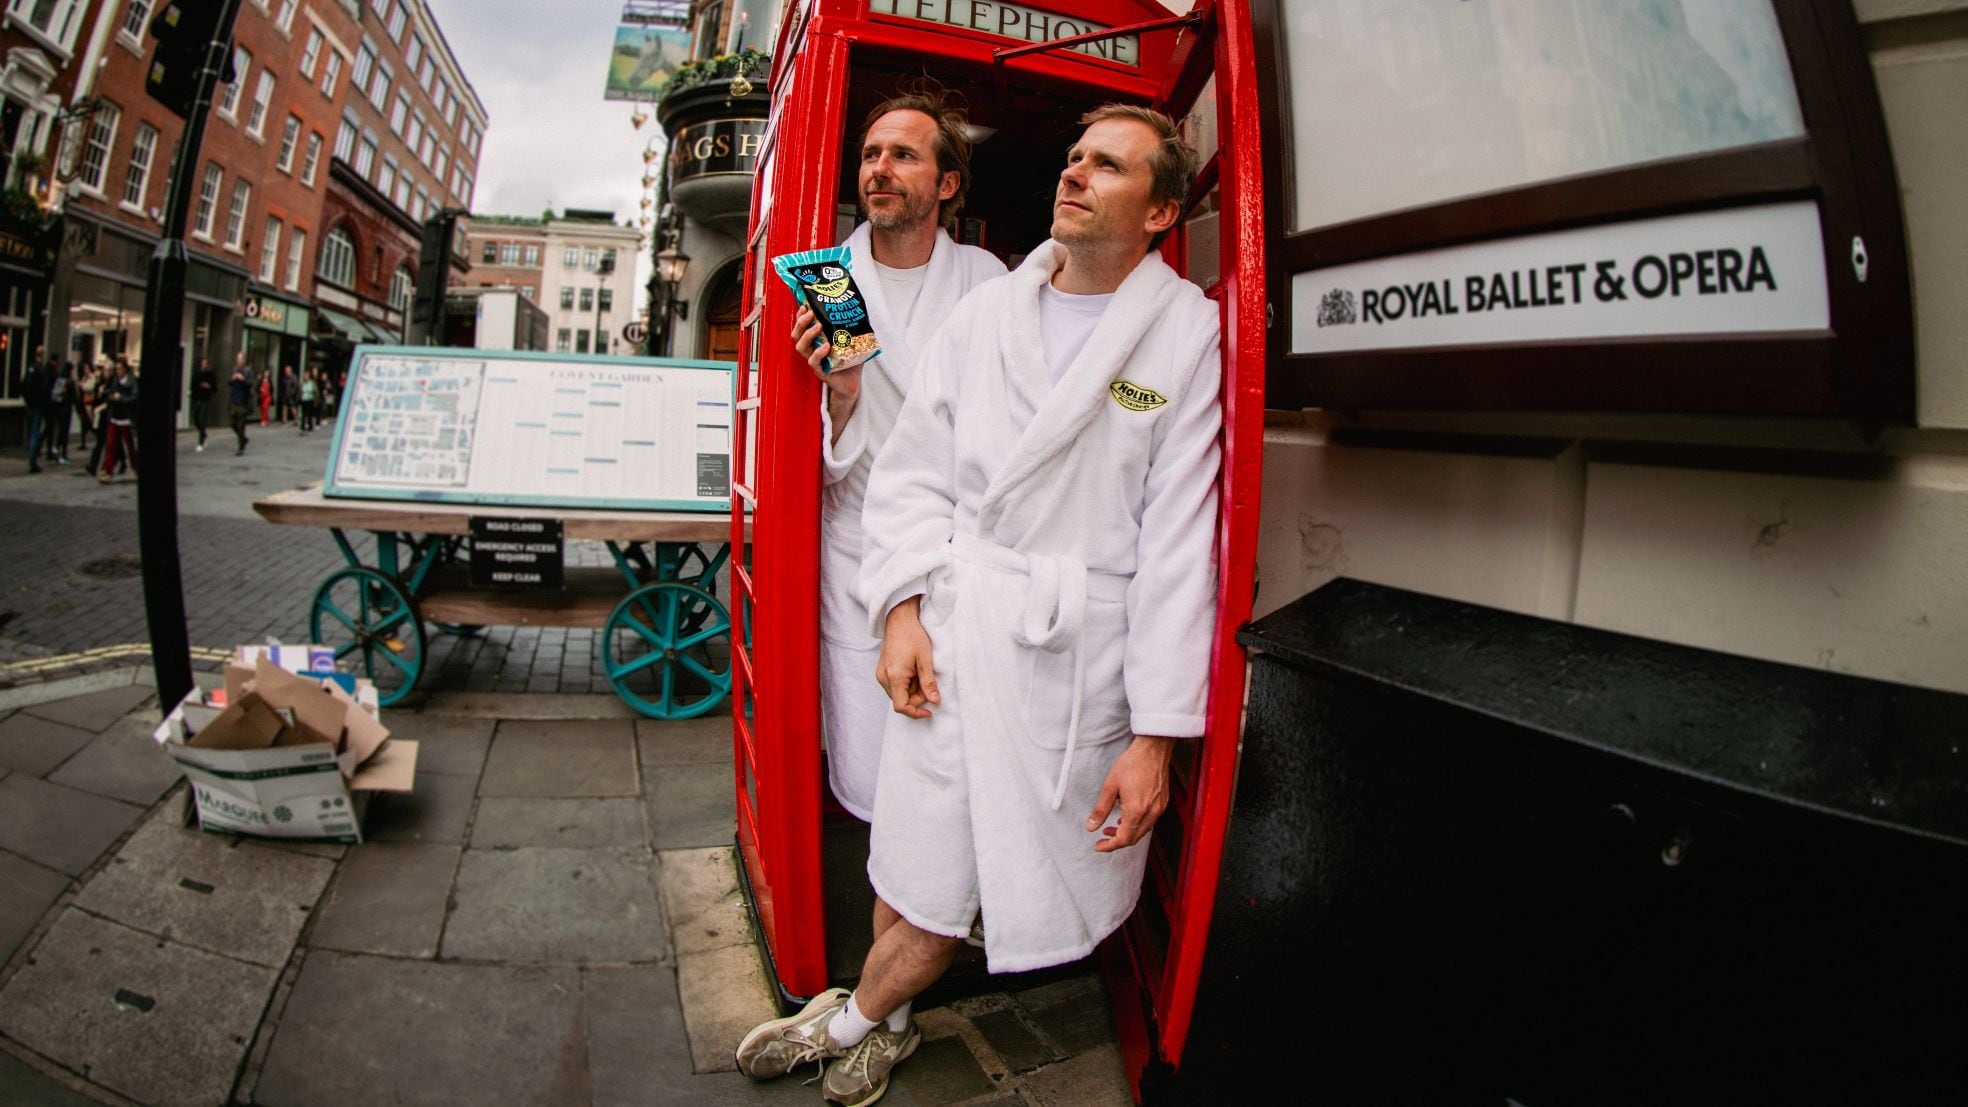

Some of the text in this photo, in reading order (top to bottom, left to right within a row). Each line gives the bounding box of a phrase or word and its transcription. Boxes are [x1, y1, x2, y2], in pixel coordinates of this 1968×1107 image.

[1362, 245, 1778, 325] ROYAL BALLET & OPERA
[817, 289, 856, 304] GRANOLA
[825, 297, 860, 312] PROTEIN
[829, 306, 864, 321] CRUNCH
[486, 522, 544, 532] ROAD CLOSED
[475, 542, 557, 553] EMERGENCY ACCESS
[495, 553, 537, 562] REQUIRED
[492, 572, 542, 582] KEEP CLEAR
